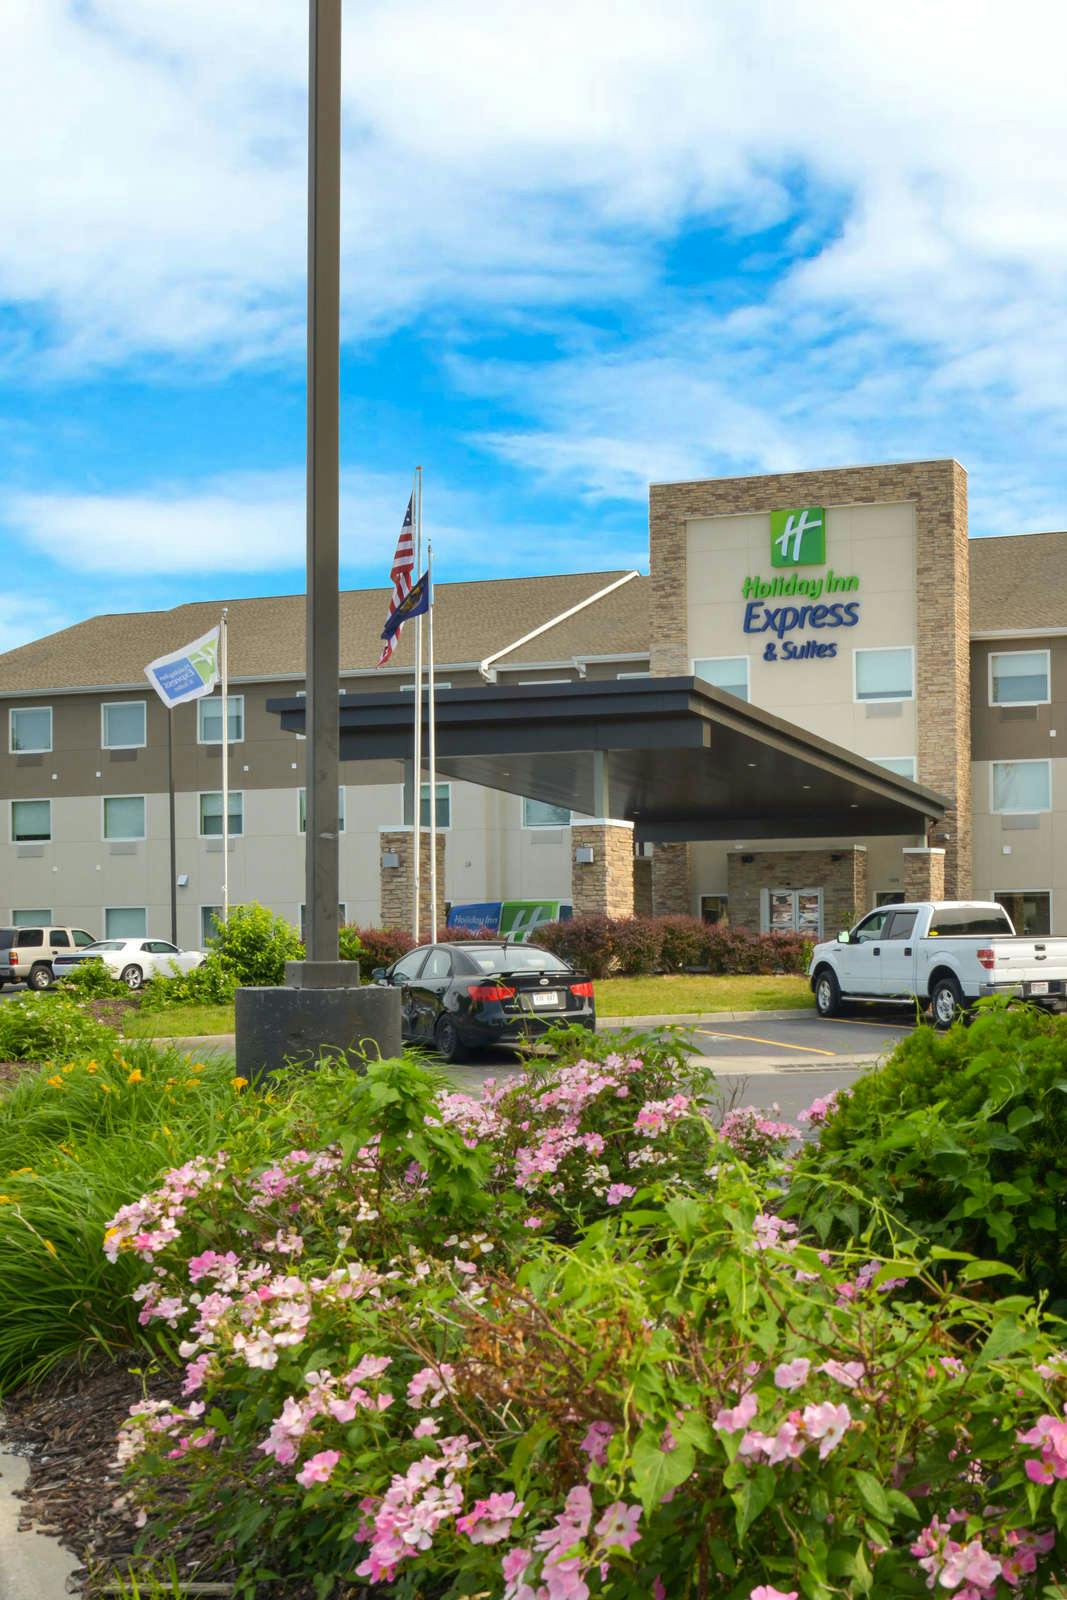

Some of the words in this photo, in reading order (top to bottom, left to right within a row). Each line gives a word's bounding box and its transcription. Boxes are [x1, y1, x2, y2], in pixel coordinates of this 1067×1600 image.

[742, 573, 823, 600] Holiday
[825, 569, 860, 593] Inn
[743, 601, 860, 639] Express
[763, 642, 778, 661] &
[780, 639, 838, 661] Suites
